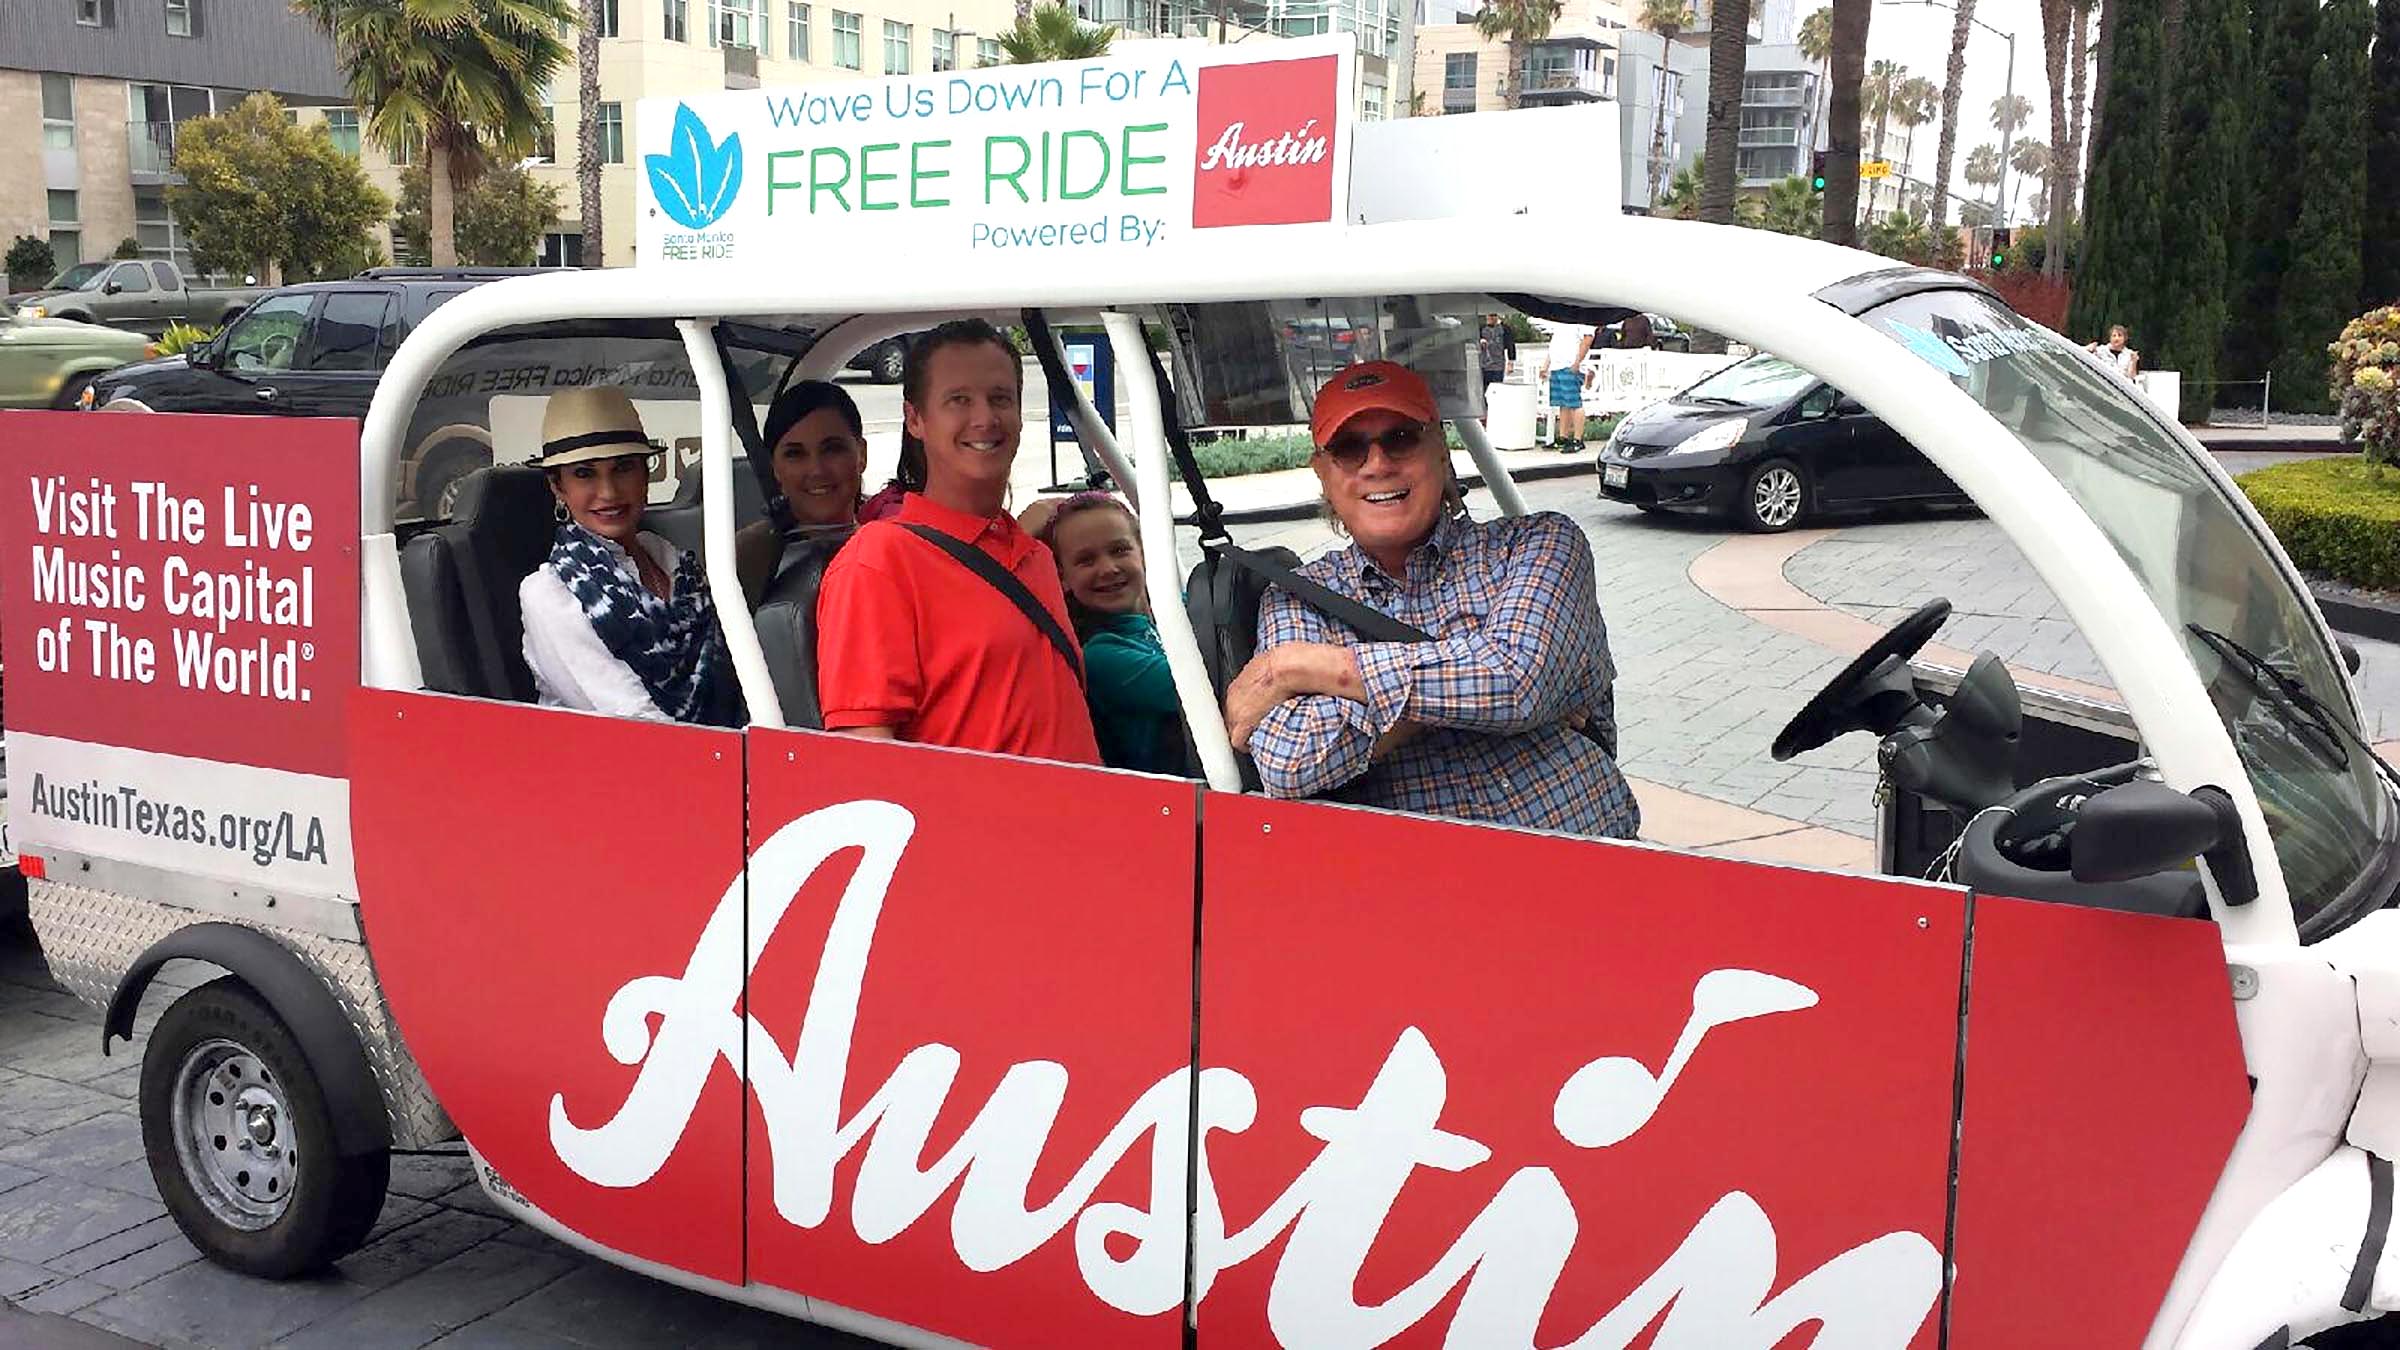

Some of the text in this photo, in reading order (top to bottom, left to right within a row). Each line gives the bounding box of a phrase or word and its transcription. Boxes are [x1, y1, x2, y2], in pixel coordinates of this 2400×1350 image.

[767, 59, 1192, 127] Wave Us Down For A
[767, 122, 1169, 216] FREE RIDE
[1200, 119, 1326, 170] Austin
[662, 243, 735, 260] FREE RIDE
[973, 215, 1166, 248] Powered By:
[30, 476, 313, 551] Visit The Live
[32, 545, 313, 634] Music Capital
[36, 617, 72, 674] of
[84, 619, 156, 684] The
[31, 772, 328, 867] AustinTexas.org/LA
[548, 799, 1957, 1350] Austin
